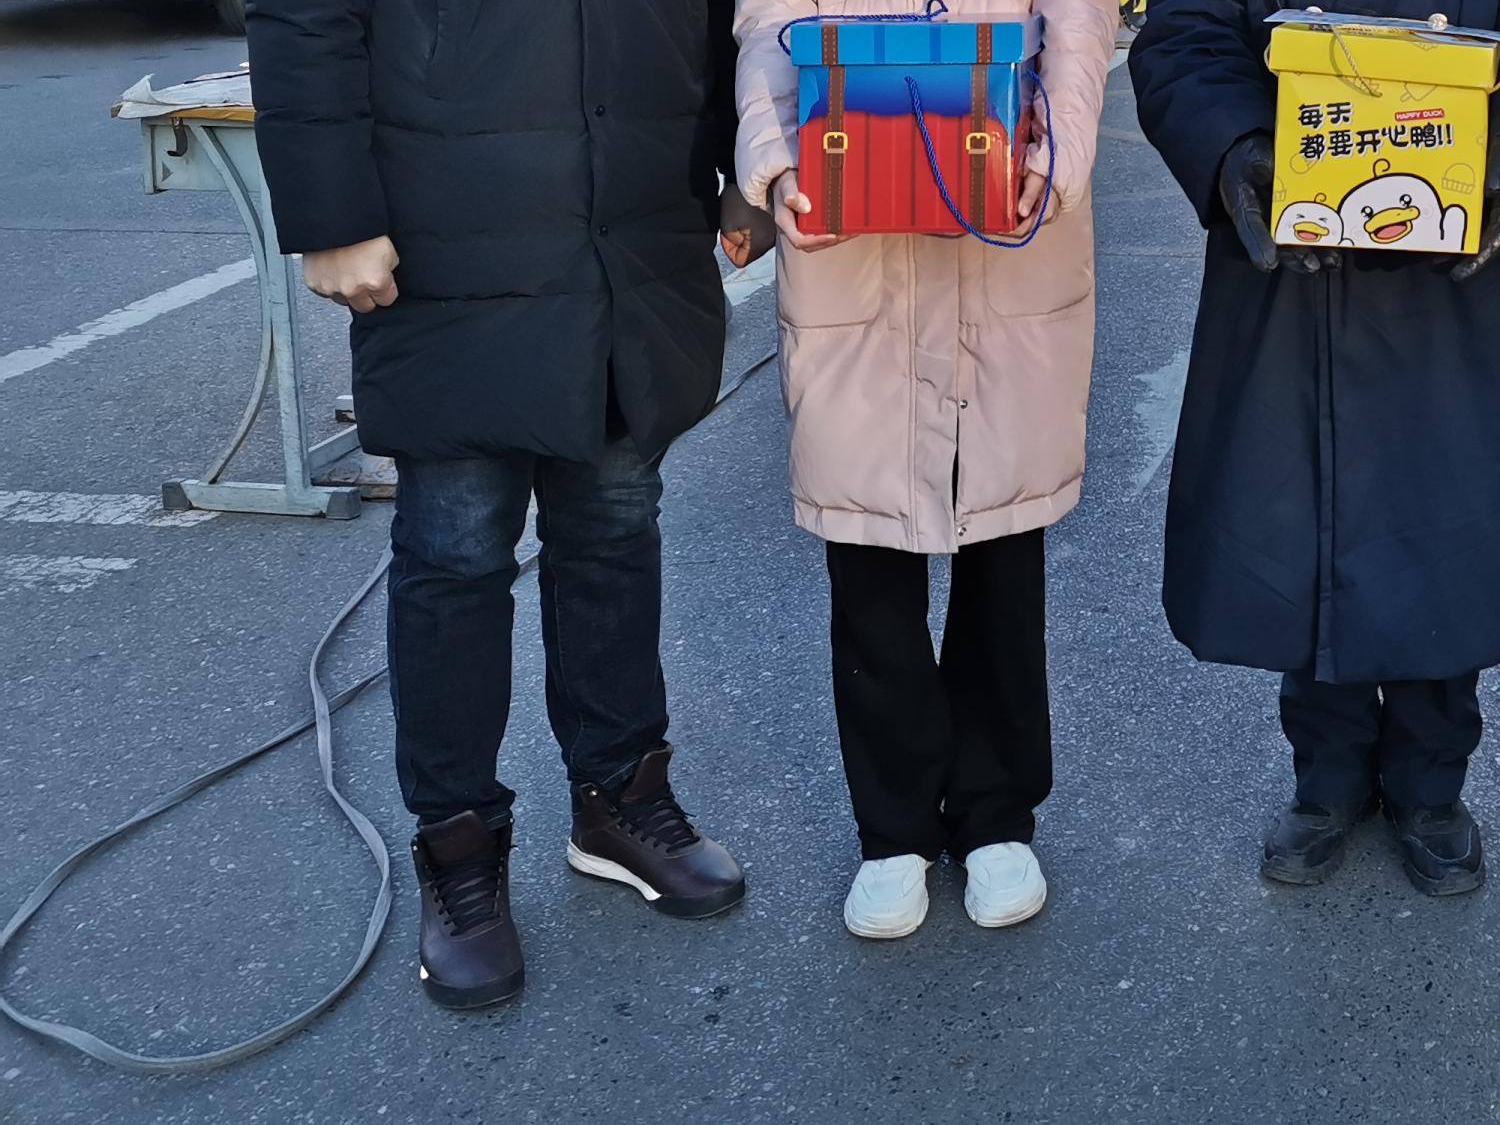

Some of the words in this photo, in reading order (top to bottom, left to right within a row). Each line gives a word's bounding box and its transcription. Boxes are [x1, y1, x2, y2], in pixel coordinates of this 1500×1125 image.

[1298, 102, 1351, 129] 每天
[1395, 112, 1421, 121] HAPPY
[1423, 109, 1443, 118] DUCK
